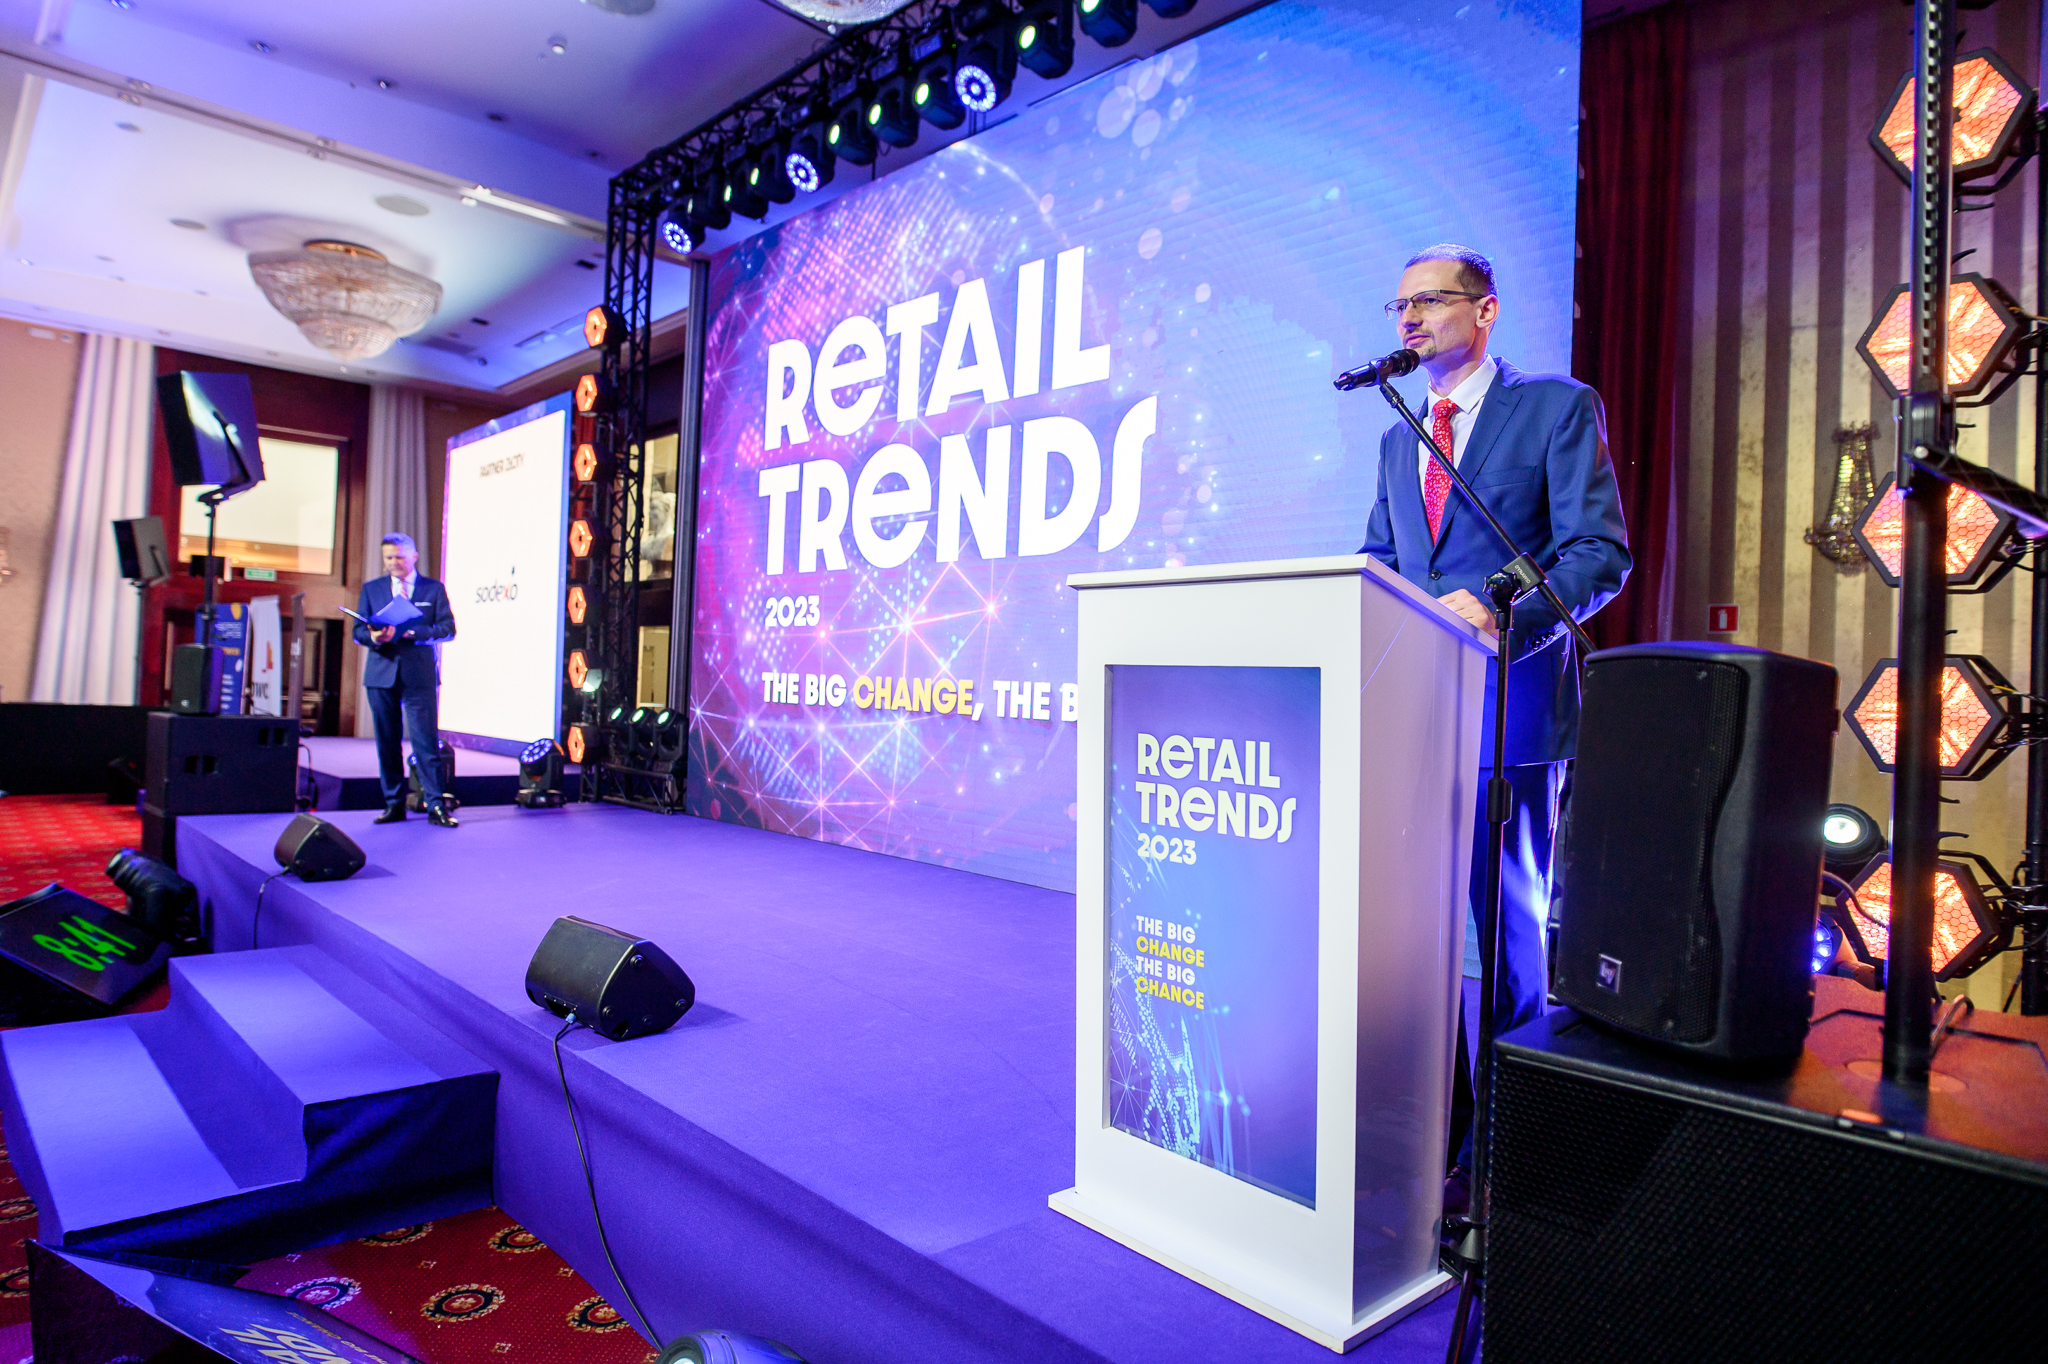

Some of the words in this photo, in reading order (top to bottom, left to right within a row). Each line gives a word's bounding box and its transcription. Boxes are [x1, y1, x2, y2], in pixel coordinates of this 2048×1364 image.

[764, 595, 821, 628] 2023
[761, 671, 800, 704] THE
[804, 673, 847, 707] BIG
[853, 675, 985, 721] CHANGE,
[992, 679, 1051, 721] THE
[1137, 832, 1197, 865] 2023
[32, 915, 137, 971] 8:41
[1135, 914, 1163, 937] THE
[1167, 921, 1196, 944] BIG
[1136, 935, 1204, 968] CHANGE
[1135, 955, 1163, 978] THE
[1166, 963, 1196, 986] BIG
[1136, 976, 1204, 1010] CHANCE
